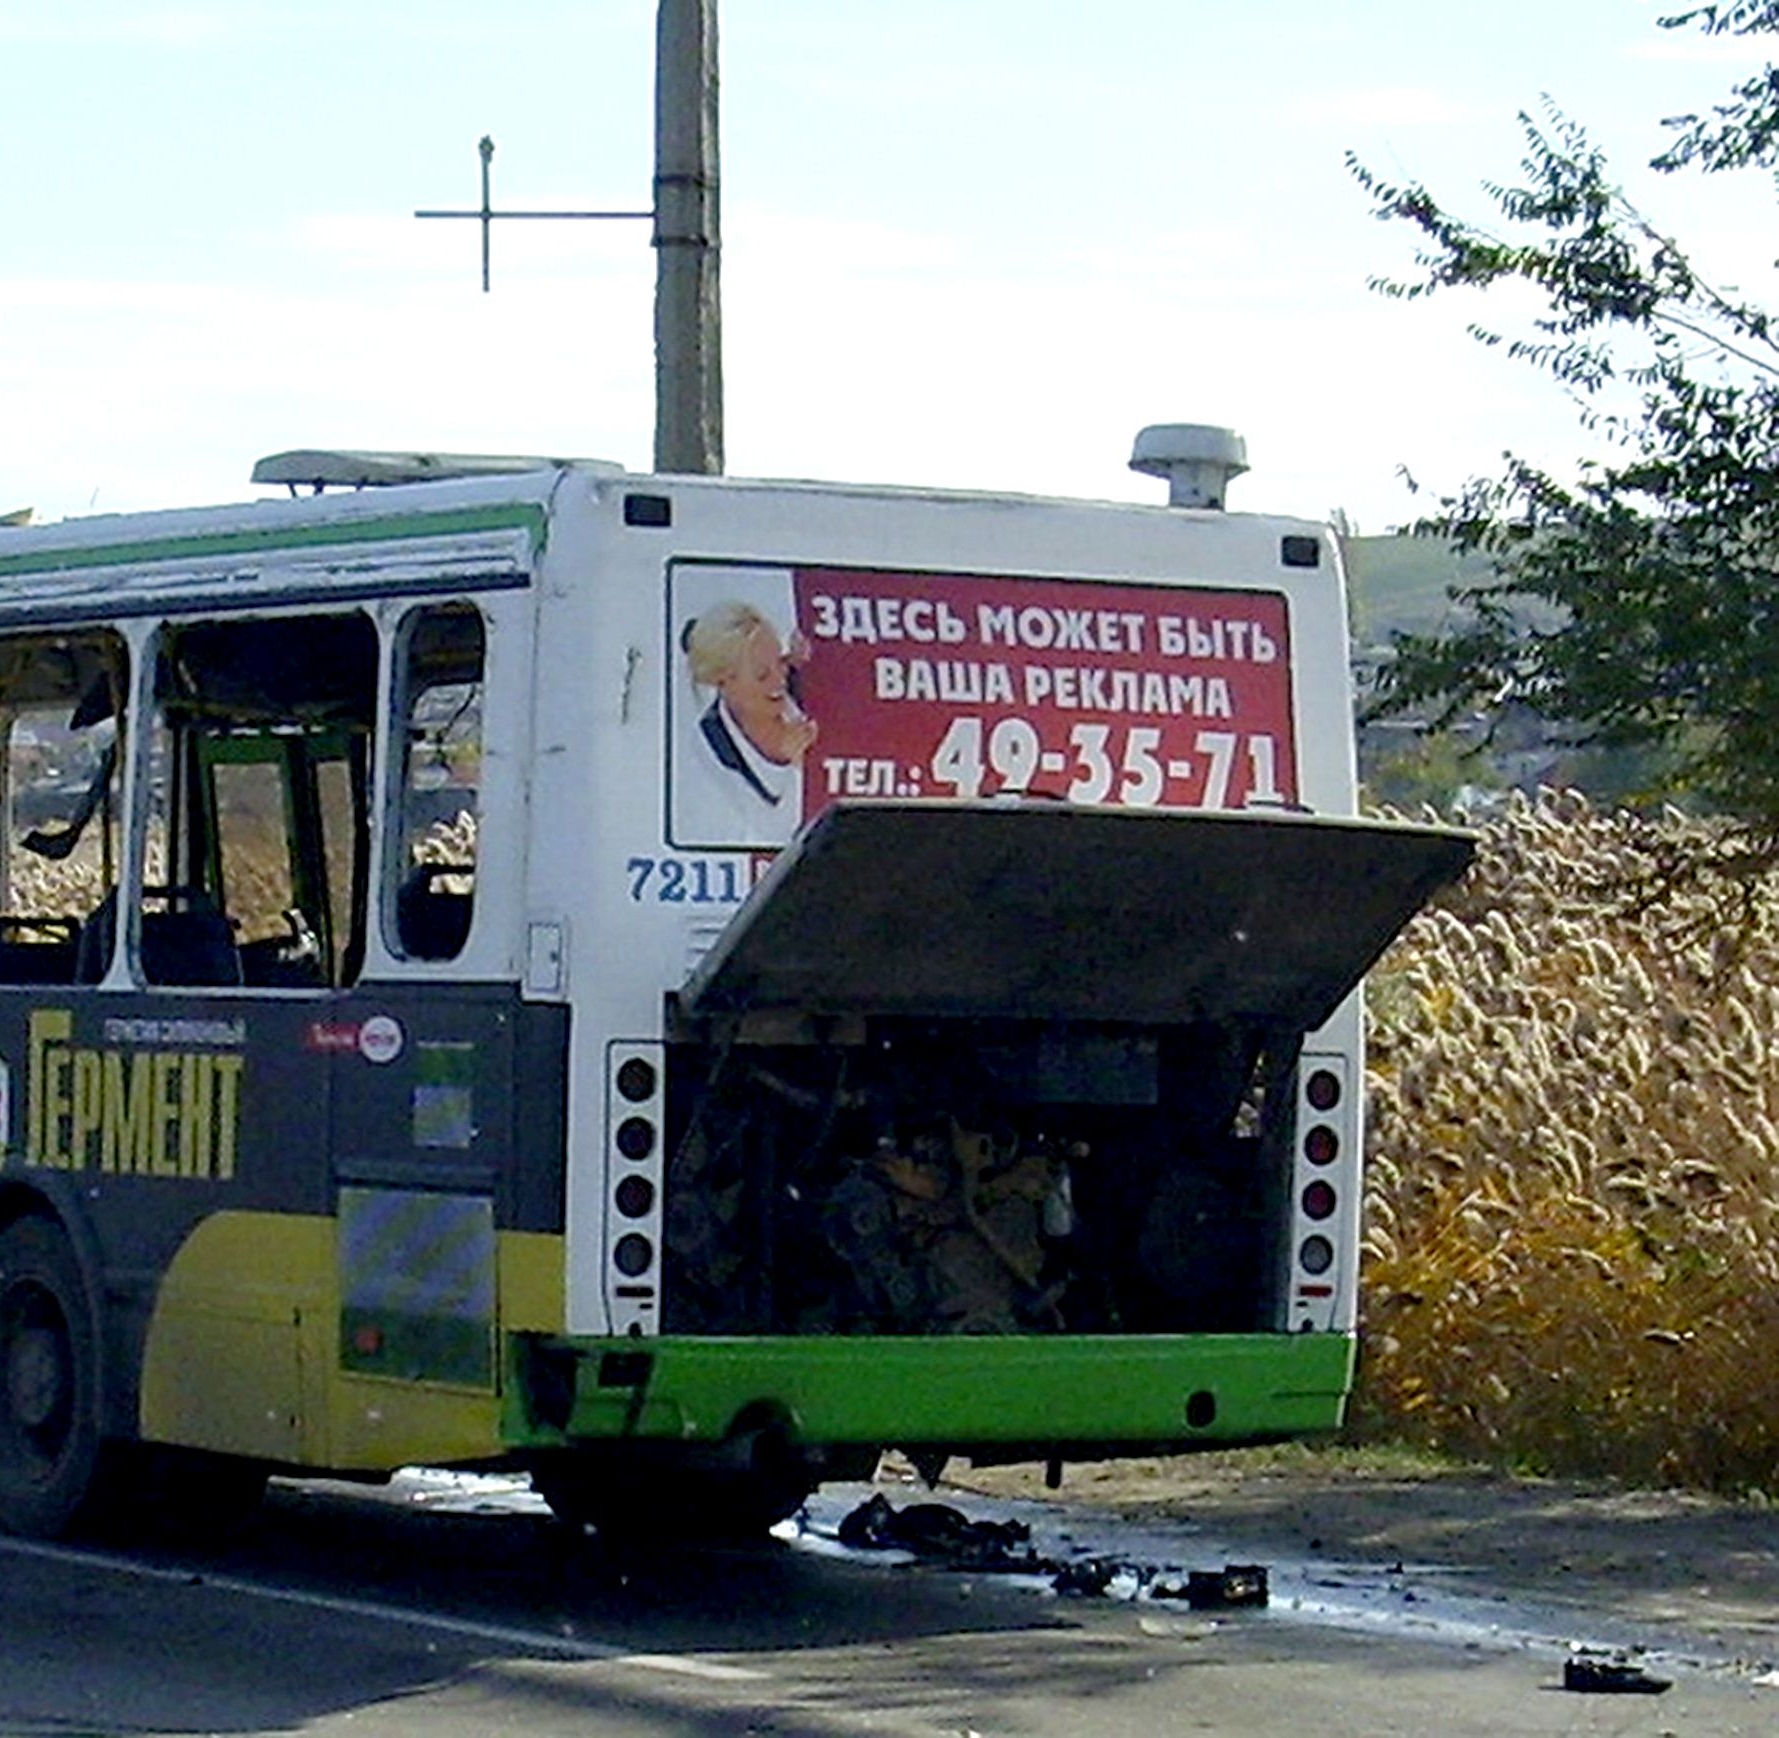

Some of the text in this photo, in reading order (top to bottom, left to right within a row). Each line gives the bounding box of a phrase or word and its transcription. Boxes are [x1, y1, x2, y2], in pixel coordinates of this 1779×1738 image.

[812, 596, 1276, 663] ЗДЕСЬ МОЖЕТ БЫТЬ
[875, 657, 1233, 718] ВАША РЕКЛАМА
[823, 717, 1283, 810] ТЕЛ.: 49-35-71
[627, 857, 742, 902] 7211
